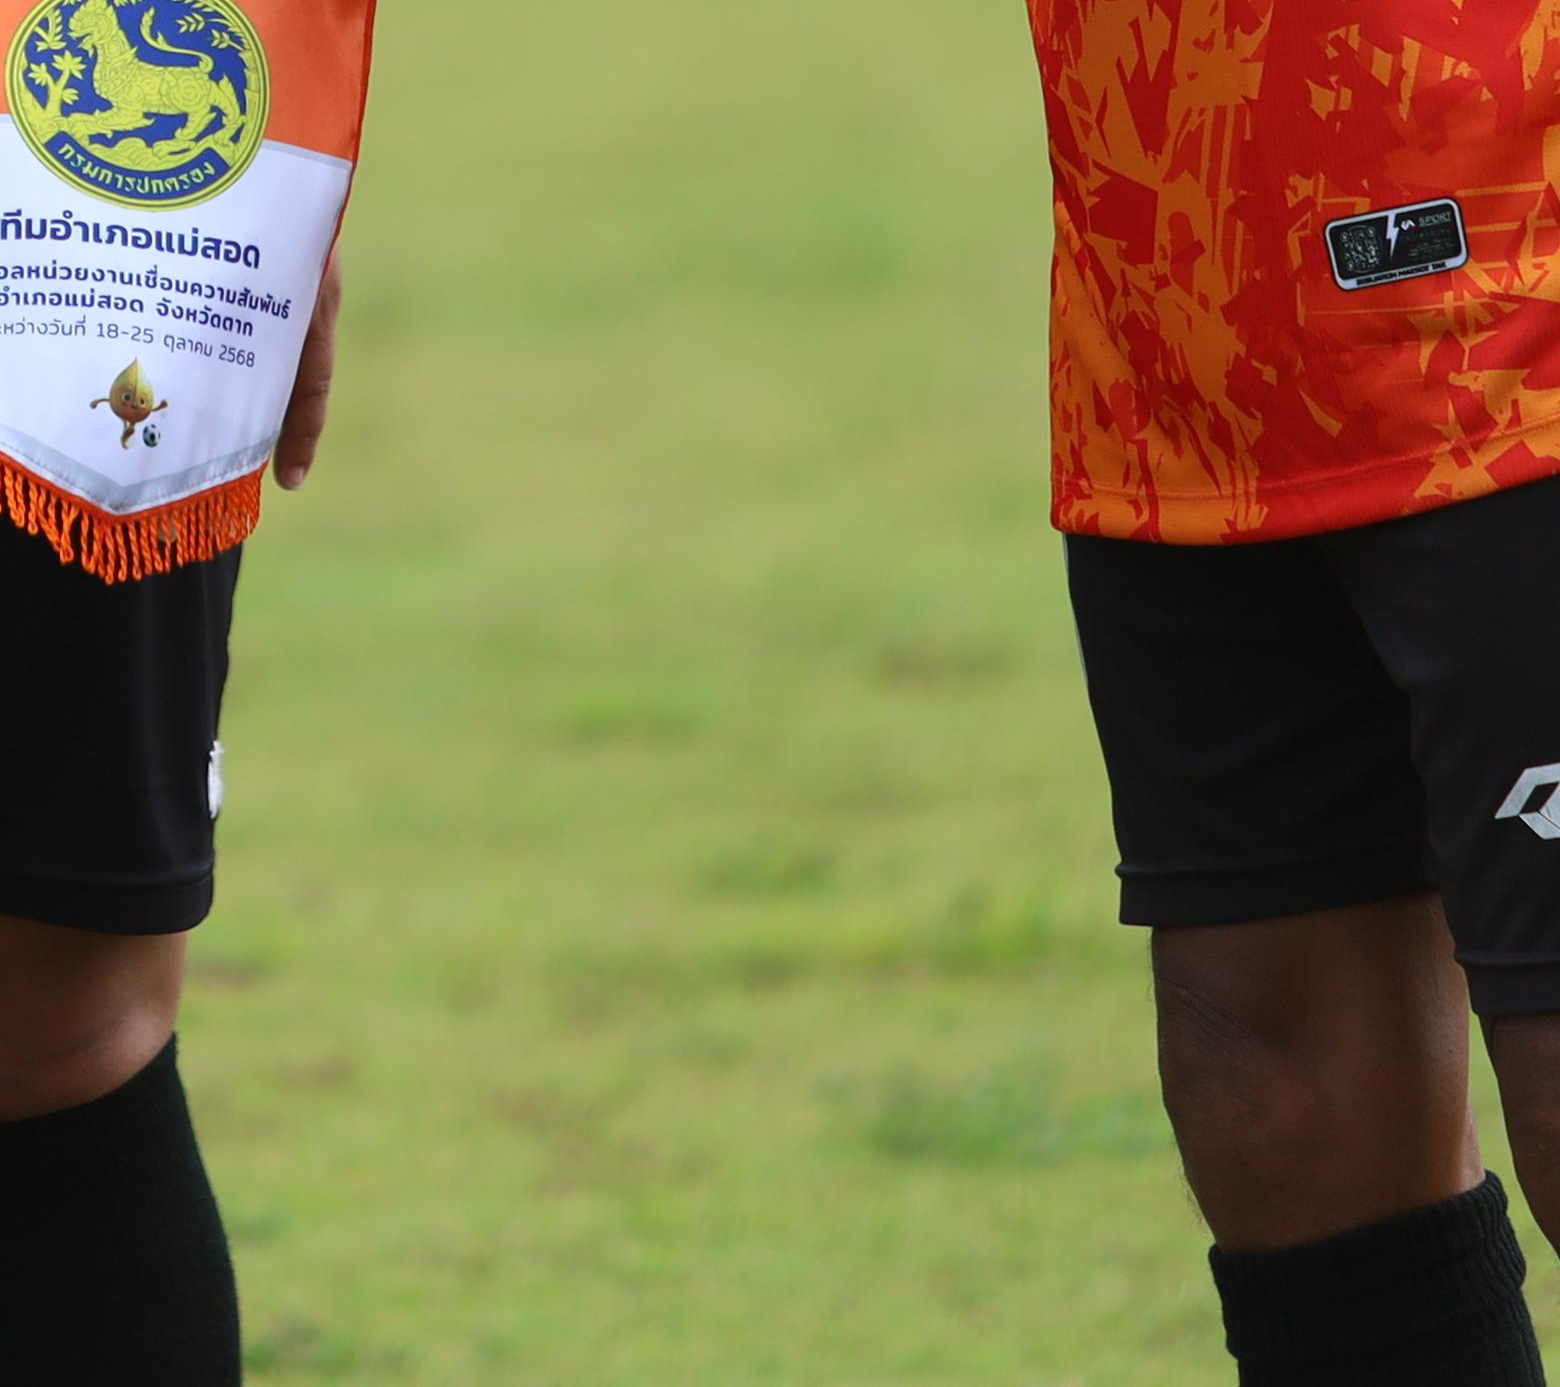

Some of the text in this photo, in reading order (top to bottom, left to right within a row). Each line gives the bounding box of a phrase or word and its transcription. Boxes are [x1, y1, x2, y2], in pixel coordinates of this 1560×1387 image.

[57, 142, 216, 195] กรมการปกครอง
[0, 208, 261, 270] ทีมอำเภอแม่สอด
[155, 299, 255, 338] จังหวัดตาก
[96, 322, 155, 345] 18-25
[163, 333, 214, 359] ตุลาคม
[218, 345, 257, 369] 2568
